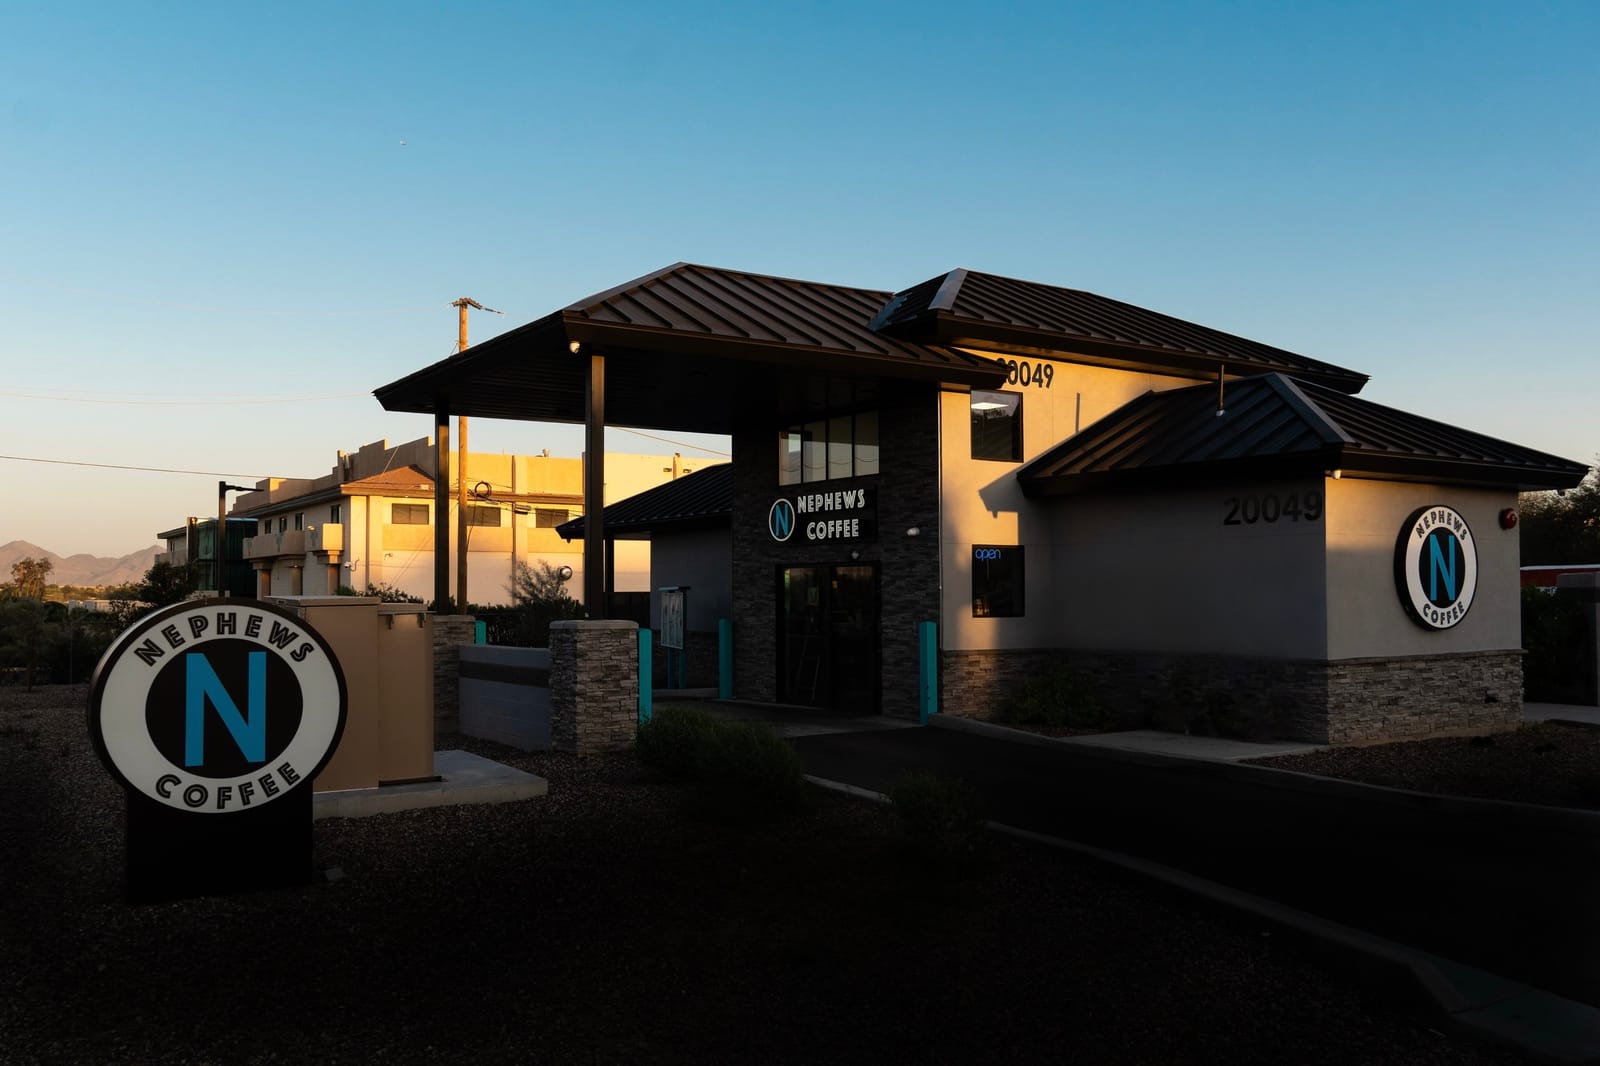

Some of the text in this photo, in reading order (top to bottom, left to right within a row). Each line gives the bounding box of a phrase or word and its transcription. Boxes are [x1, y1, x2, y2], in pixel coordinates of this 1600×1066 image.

[797, 489, 865, 514] NEPHEWS
[1224, 490, 1322, 525] 20049
[775, 503, 790, 537] N
[806, 519, 859, 540] COFFEE
[1416, 510, 1467, 540] NEPHEWS
[975, 548, 1001, 561] open
[1429, 533, 1456, 601] N
[1423, 601, 1464, 625] COFFEE
[134, 613, 314, 666] NEPHEWS
[185, 651, 268, 767] N
[156, 762, 300, 809] COFFEE
